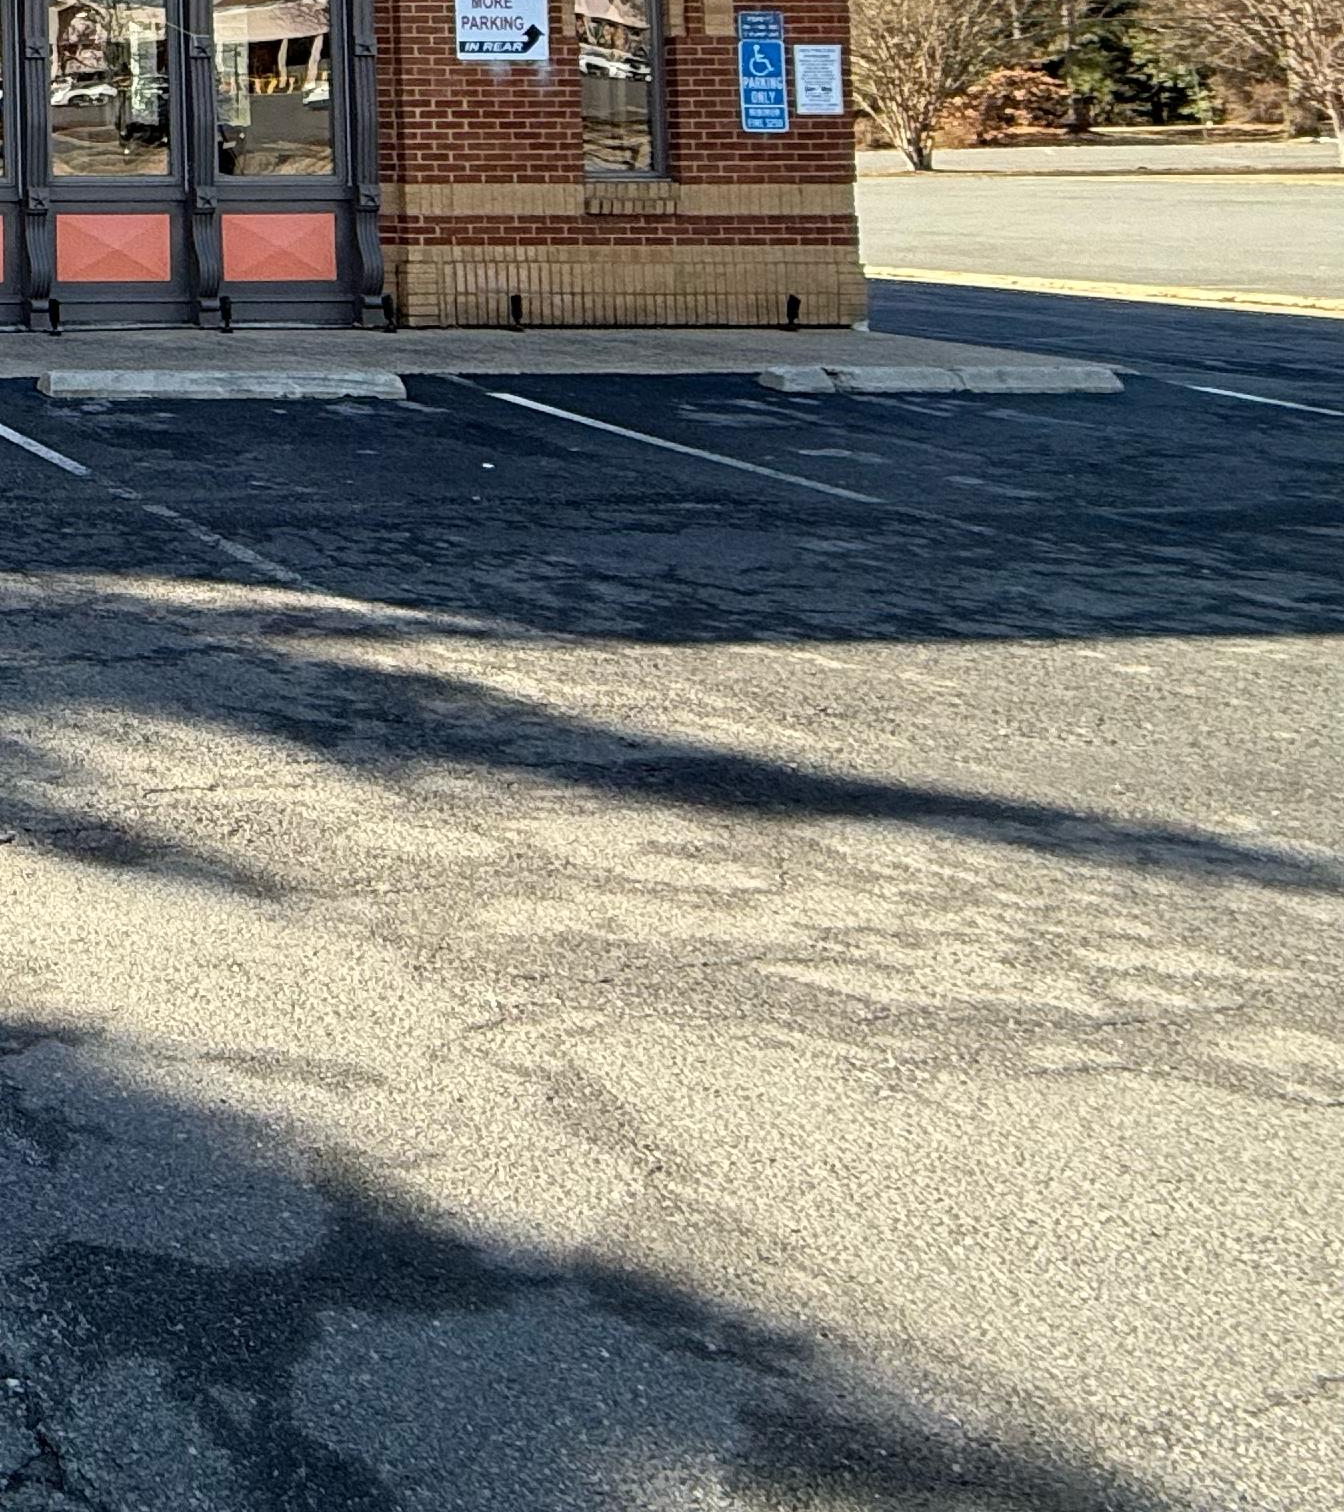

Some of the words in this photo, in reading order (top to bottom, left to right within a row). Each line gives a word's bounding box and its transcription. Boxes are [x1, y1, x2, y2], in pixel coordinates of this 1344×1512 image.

[460, 15, 524, 31] PARKING
[464, 42, 480, 52] IN
[482, 42, 524, 52] REAR
[743, 76, 783, 90] PARKING
[751, 90, 776, 104] ONLY
